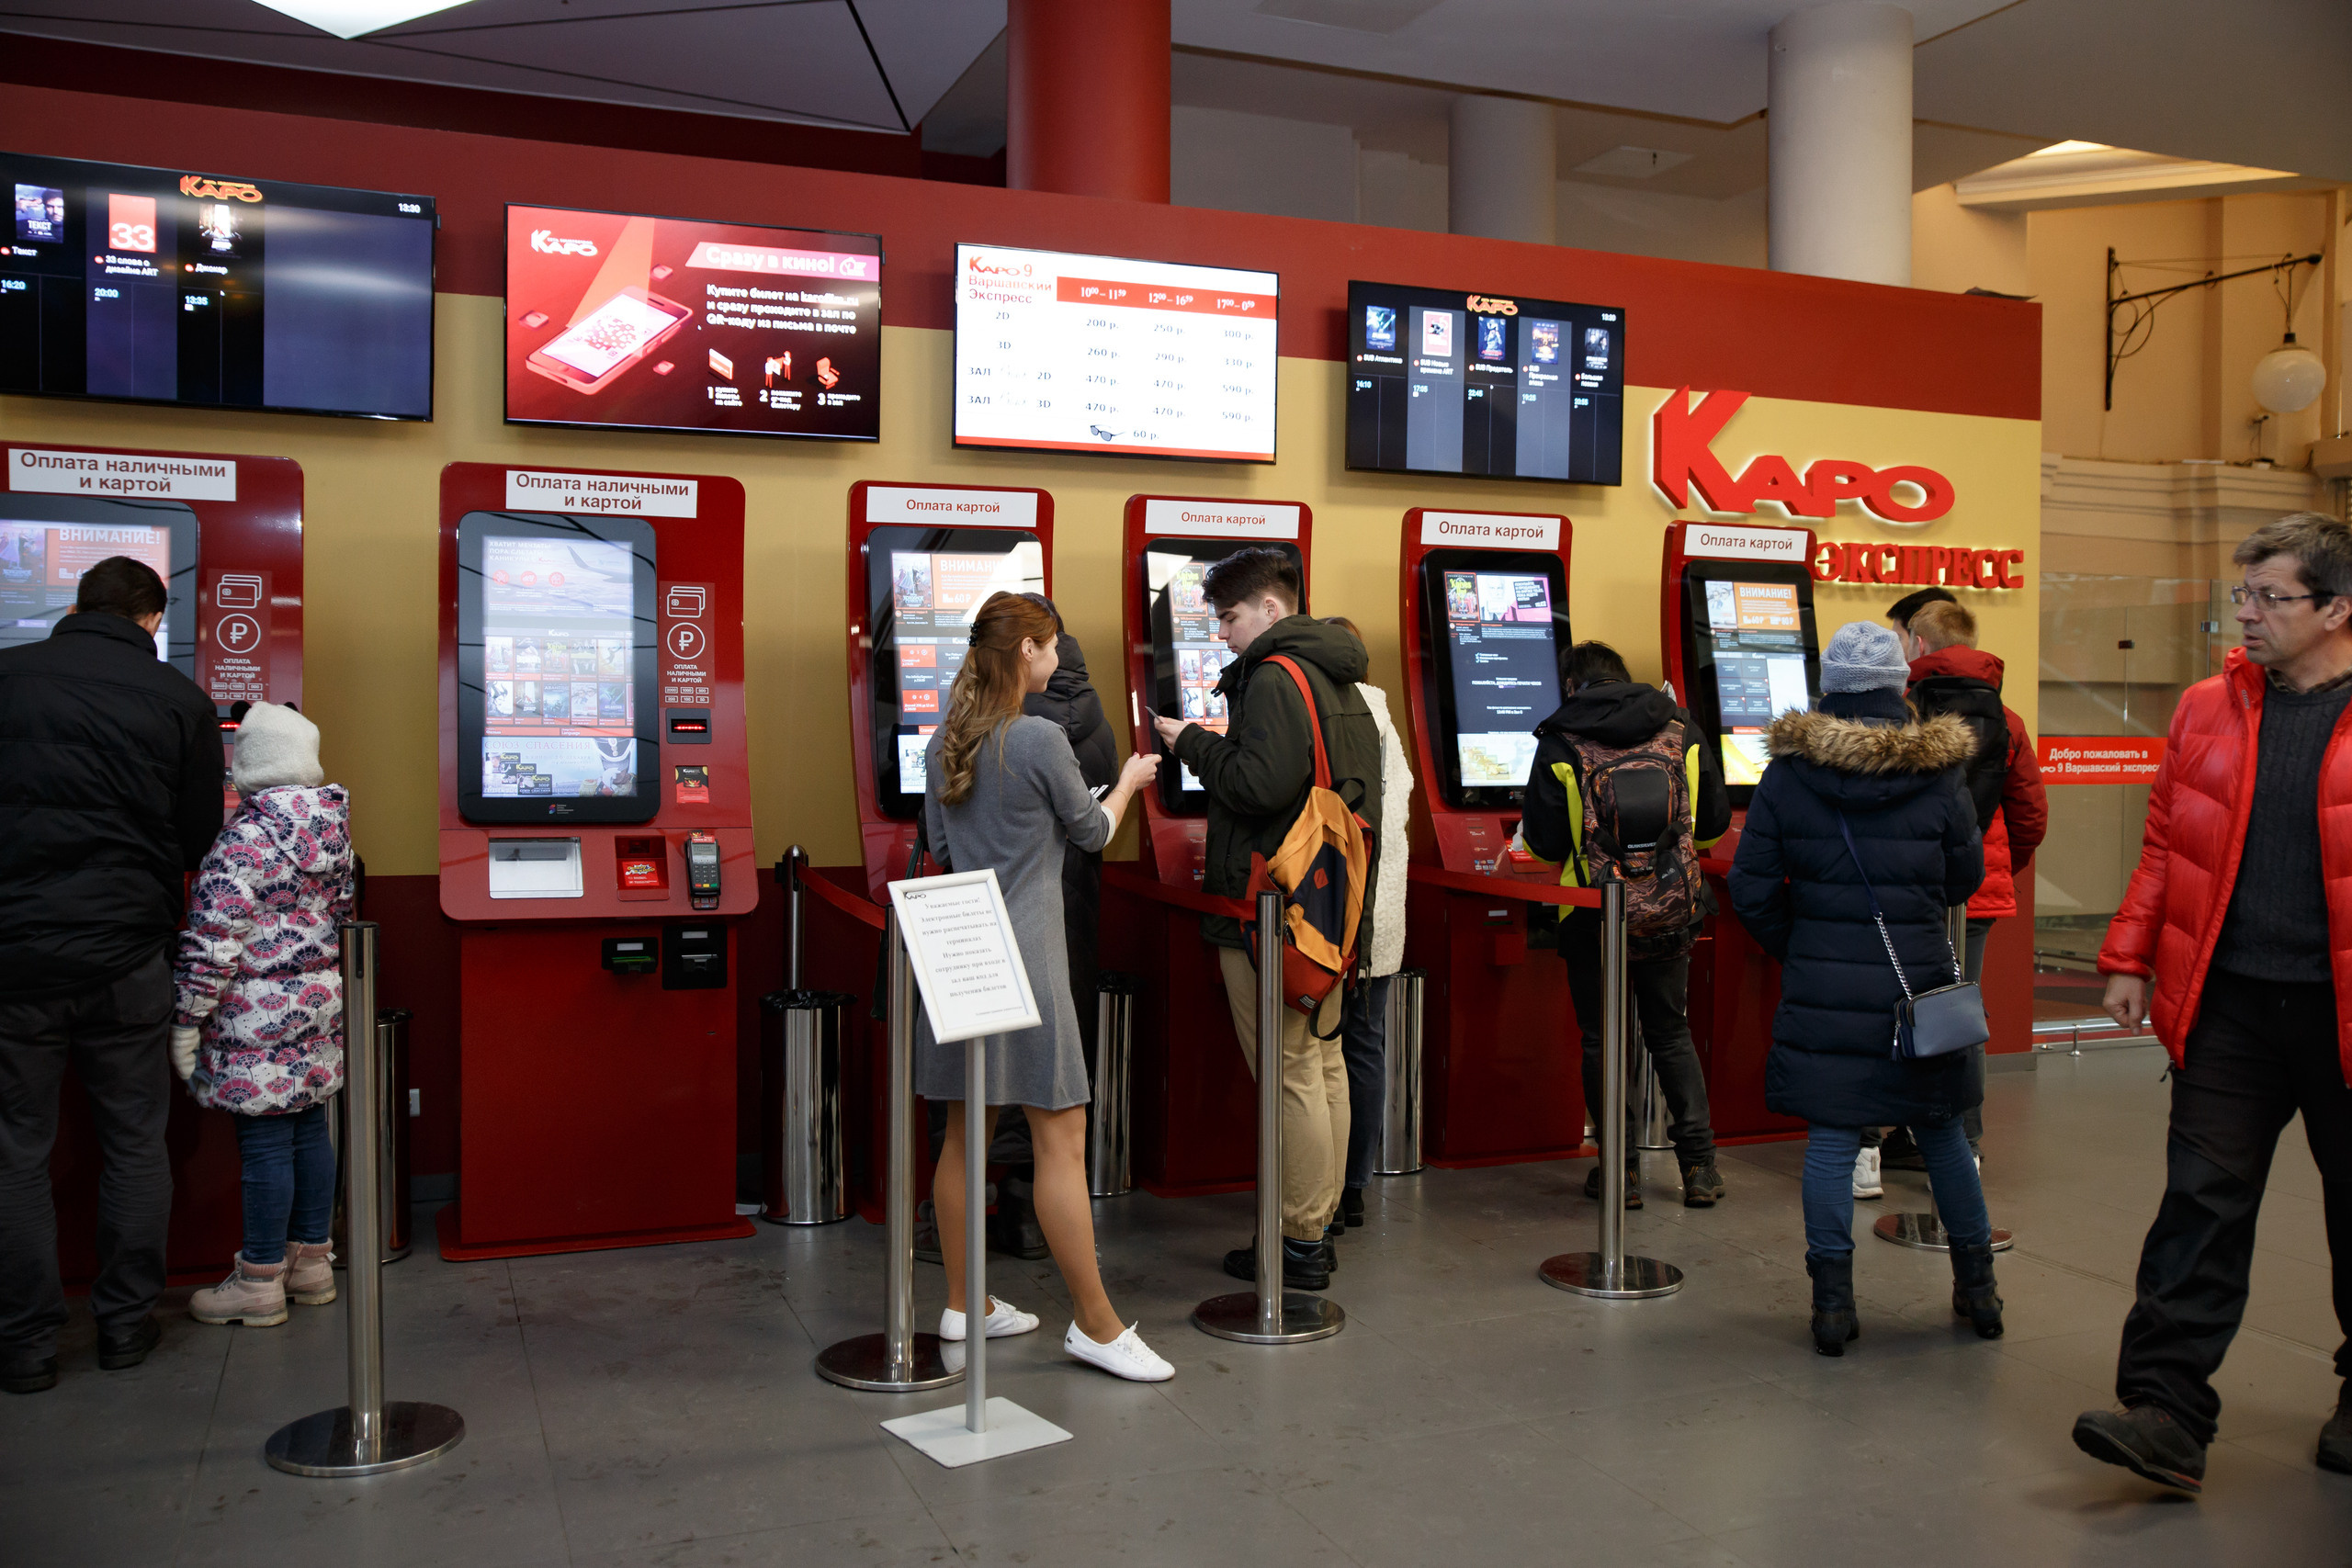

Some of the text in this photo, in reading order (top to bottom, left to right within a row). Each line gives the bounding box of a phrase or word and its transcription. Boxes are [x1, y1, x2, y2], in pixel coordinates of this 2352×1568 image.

[180, 174, 263, 202] КАРО
[111, 223, 154, 250] 33
[531, 229, 597, 256] КАРО
[12, 246, 38, 256] Текст
[106, 255, 117, 264] 33
[118, 258, 142, 266] слова
[706, 246, 834, 273] Сразу в кино!
[141, 267, 158, 276] ART
[196, 263, 228, 275] Джокер
[1024, 265, 1033, 276] 9
[1, 279, 26, 290] 16:20
[95, 288, 119, 299] 20:00
[707, 284, 748, 298] Купите
[750, 288, 784, 300] билет
[786, 293, 799, 301] на
[969, 288, 1033, 304] Экспресс
[185, 296, 208, 306] 13:35
[1466, 294, 1518, 316] КАРО
[707, 301, 715, 310] и
[717, 302, 749, 314] сразу
[751, 304, 810, 317] проходите
[821, 310, 840, 319] зал
[842, 311, 856, 320] по
[996, 311, 1010, 320] 2D
[707, 314, 856, 334] QR-коду из письма в почте
[1087, 319, 1106, 328] 200
[996, 341, 1012, 349] 3D
[1088, 347, 1107, 356] 260
[968, 367, 990, 376] ЗАЛ
[1037, 372, 1051, 380] 2D
[707, 387, 713, 399] 1
[760, 389, 768, 402] 2
[818, 393, 826, 405] 3
[967, 396, 990, 404] ЗАЛ
[1036, 400, 1051, 408] 3D
[1652, 384, 1955, 523] КАРО
[21, 452, 226, 478] Оплата наличными
[80, 477, 171, 493] и картой
[516, 473, 689, 496] Оплата наличными
[564, 496, 641, 512] и картой
[906, 498, 1001, 513] Оплата картой
[1181, 512, 1266, 526] Оплата картой
[59, 528, 160, 545] ВНИМАНИЕ!
[1439, 521, 1544, 539] Оплата картой
[1700, 533, 1792, 553] Оплата картой
[1815, 541, 2024, 590] ЭКСПРЕСС
[1739, 587, 1792, 599] ВНИМАНИЕ!
[484, 740, 590, 750] СОЮЗ СПАСЕНИЯ
[2050, 748, 2081, 761] Добро
[2084, 750, 2140, 759] пожаловать
[2058, 762, 2063, 773] 9
[2065, 762, 2120, 774] Варшавский
[2122, 764, 2160, 773] экспрес
[925, 901, 960, 909] Уважаемые
[922, 913, 961, 923] Электронные
[944, 924, 989, 933] распечатывать
[943, 951, 964, 959] Нужно
